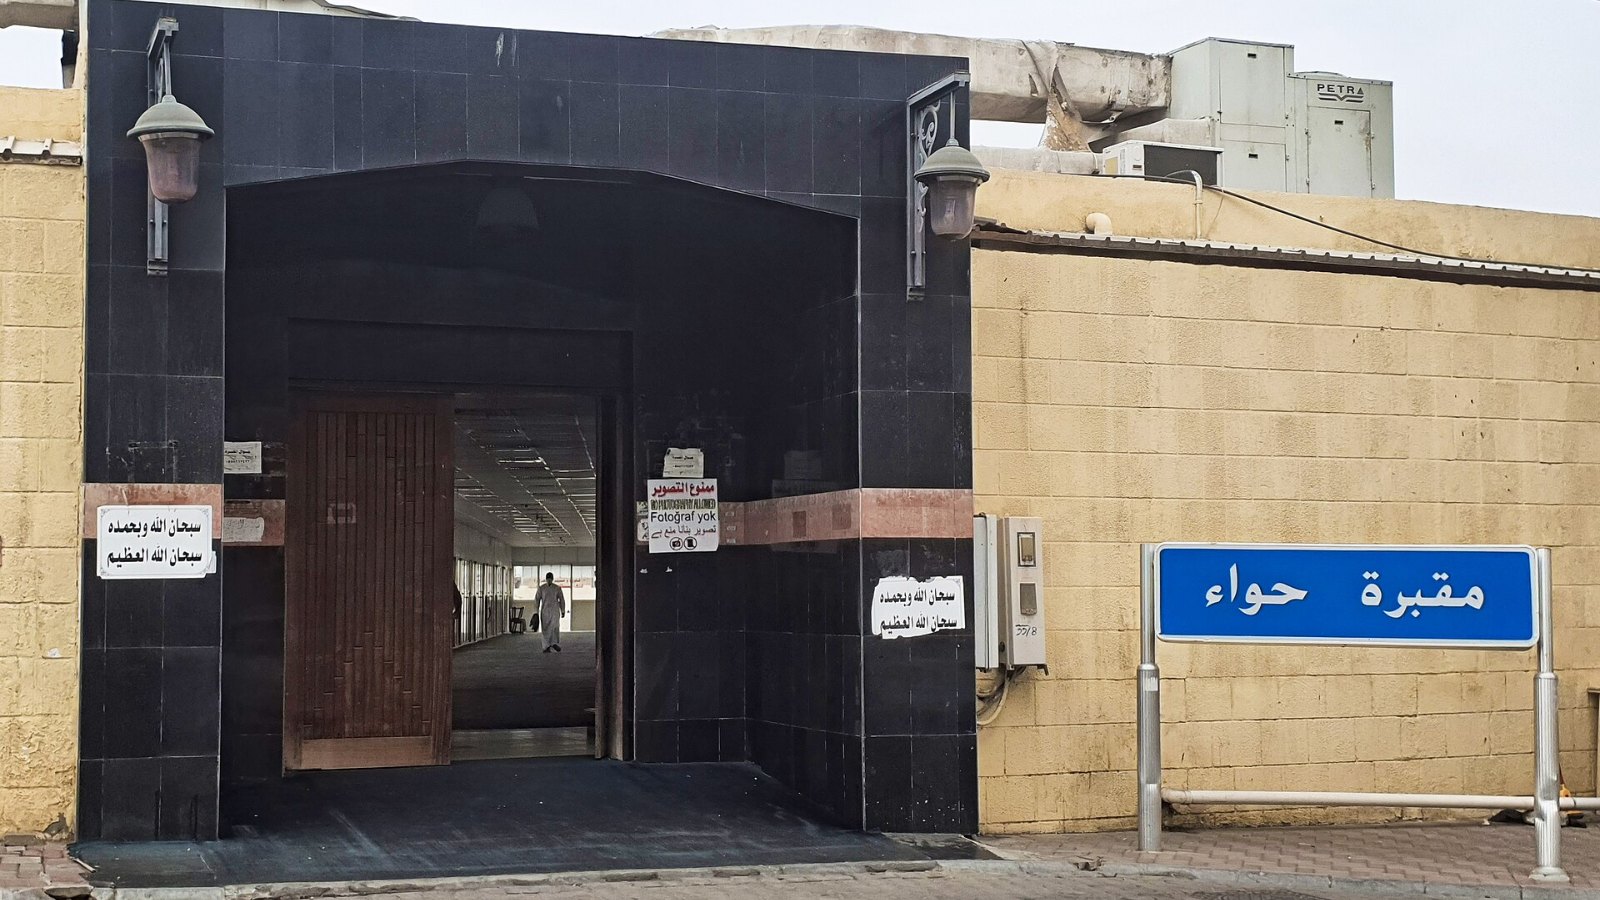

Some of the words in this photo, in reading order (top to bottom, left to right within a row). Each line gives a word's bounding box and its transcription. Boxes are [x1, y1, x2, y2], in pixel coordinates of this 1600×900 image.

[1317, 84, 1364, 95] PETRA
[651, 482, 688, 497] التصوير
[689, 482, 715, 496] ممنوع
[150, 514, 167, 533] الله
[650, 511, 695, 524] Fotoğraf
[697, 511, 717, 523] yok
[108, 520, 148, 538] وبحمده
[168, 518, 202, 538] سبحان
[664, 525, 676, 538] منع
[107, 547, 149, 568] العظيم
[151, 544, 168, 562] الله
[169, 547, 203, 567] سبحان
[913, 586, 927, 602] الله
[928, 588, 955, 606] سبحان
[1204, 562, 1309, 616] حواء
[1360, 570, 1485, 619] مقبرة
[879, 591, 912, 606] وبحمده
[881, 615, 914, 634] العظيم
[915, 611, 929, 629] الله
[930, 614, 958, 632] سبحان
